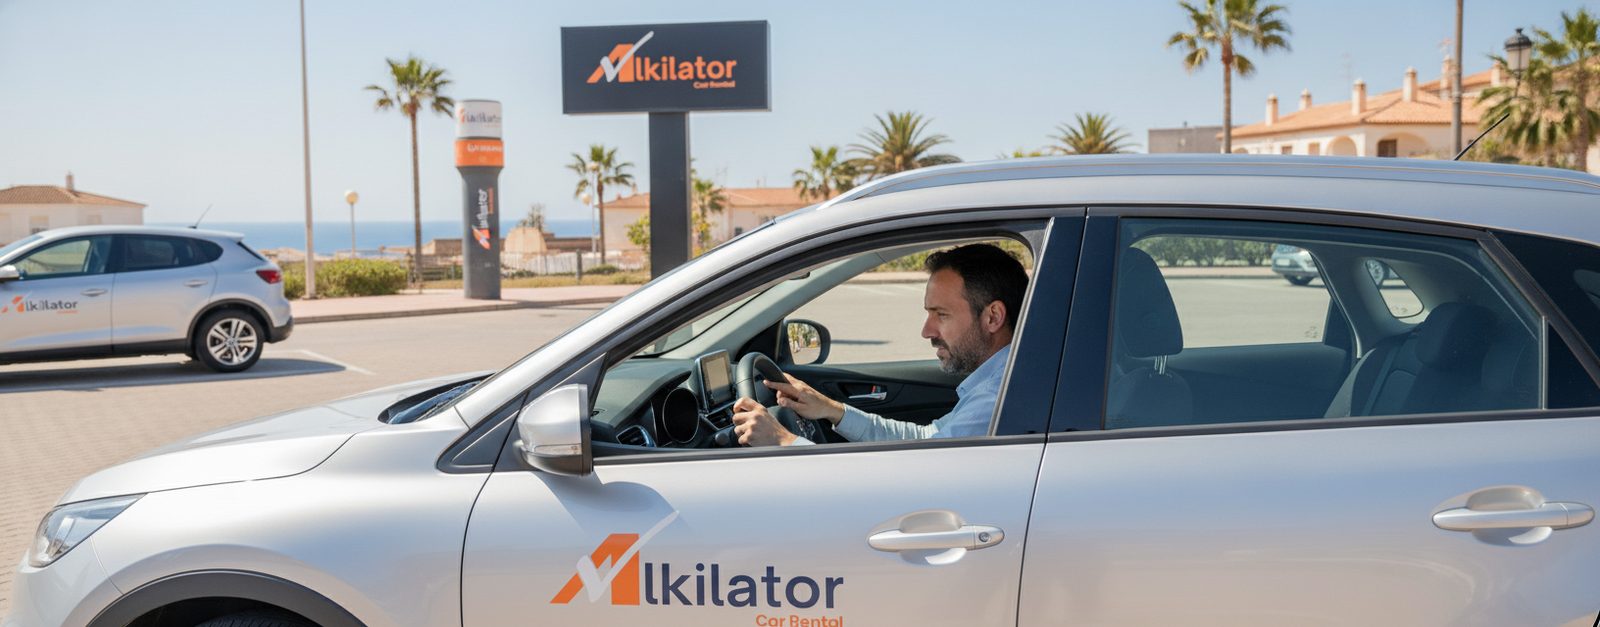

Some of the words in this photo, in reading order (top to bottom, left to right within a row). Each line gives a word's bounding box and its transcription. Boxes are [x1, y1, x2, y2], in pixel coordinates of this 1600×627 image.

[586, 38, 738, 83] Alkilator
[550, 525, 844, 609] Alkilator
[756, 614, 785, 627] Car
[789, 614, 843, 627] Rental
